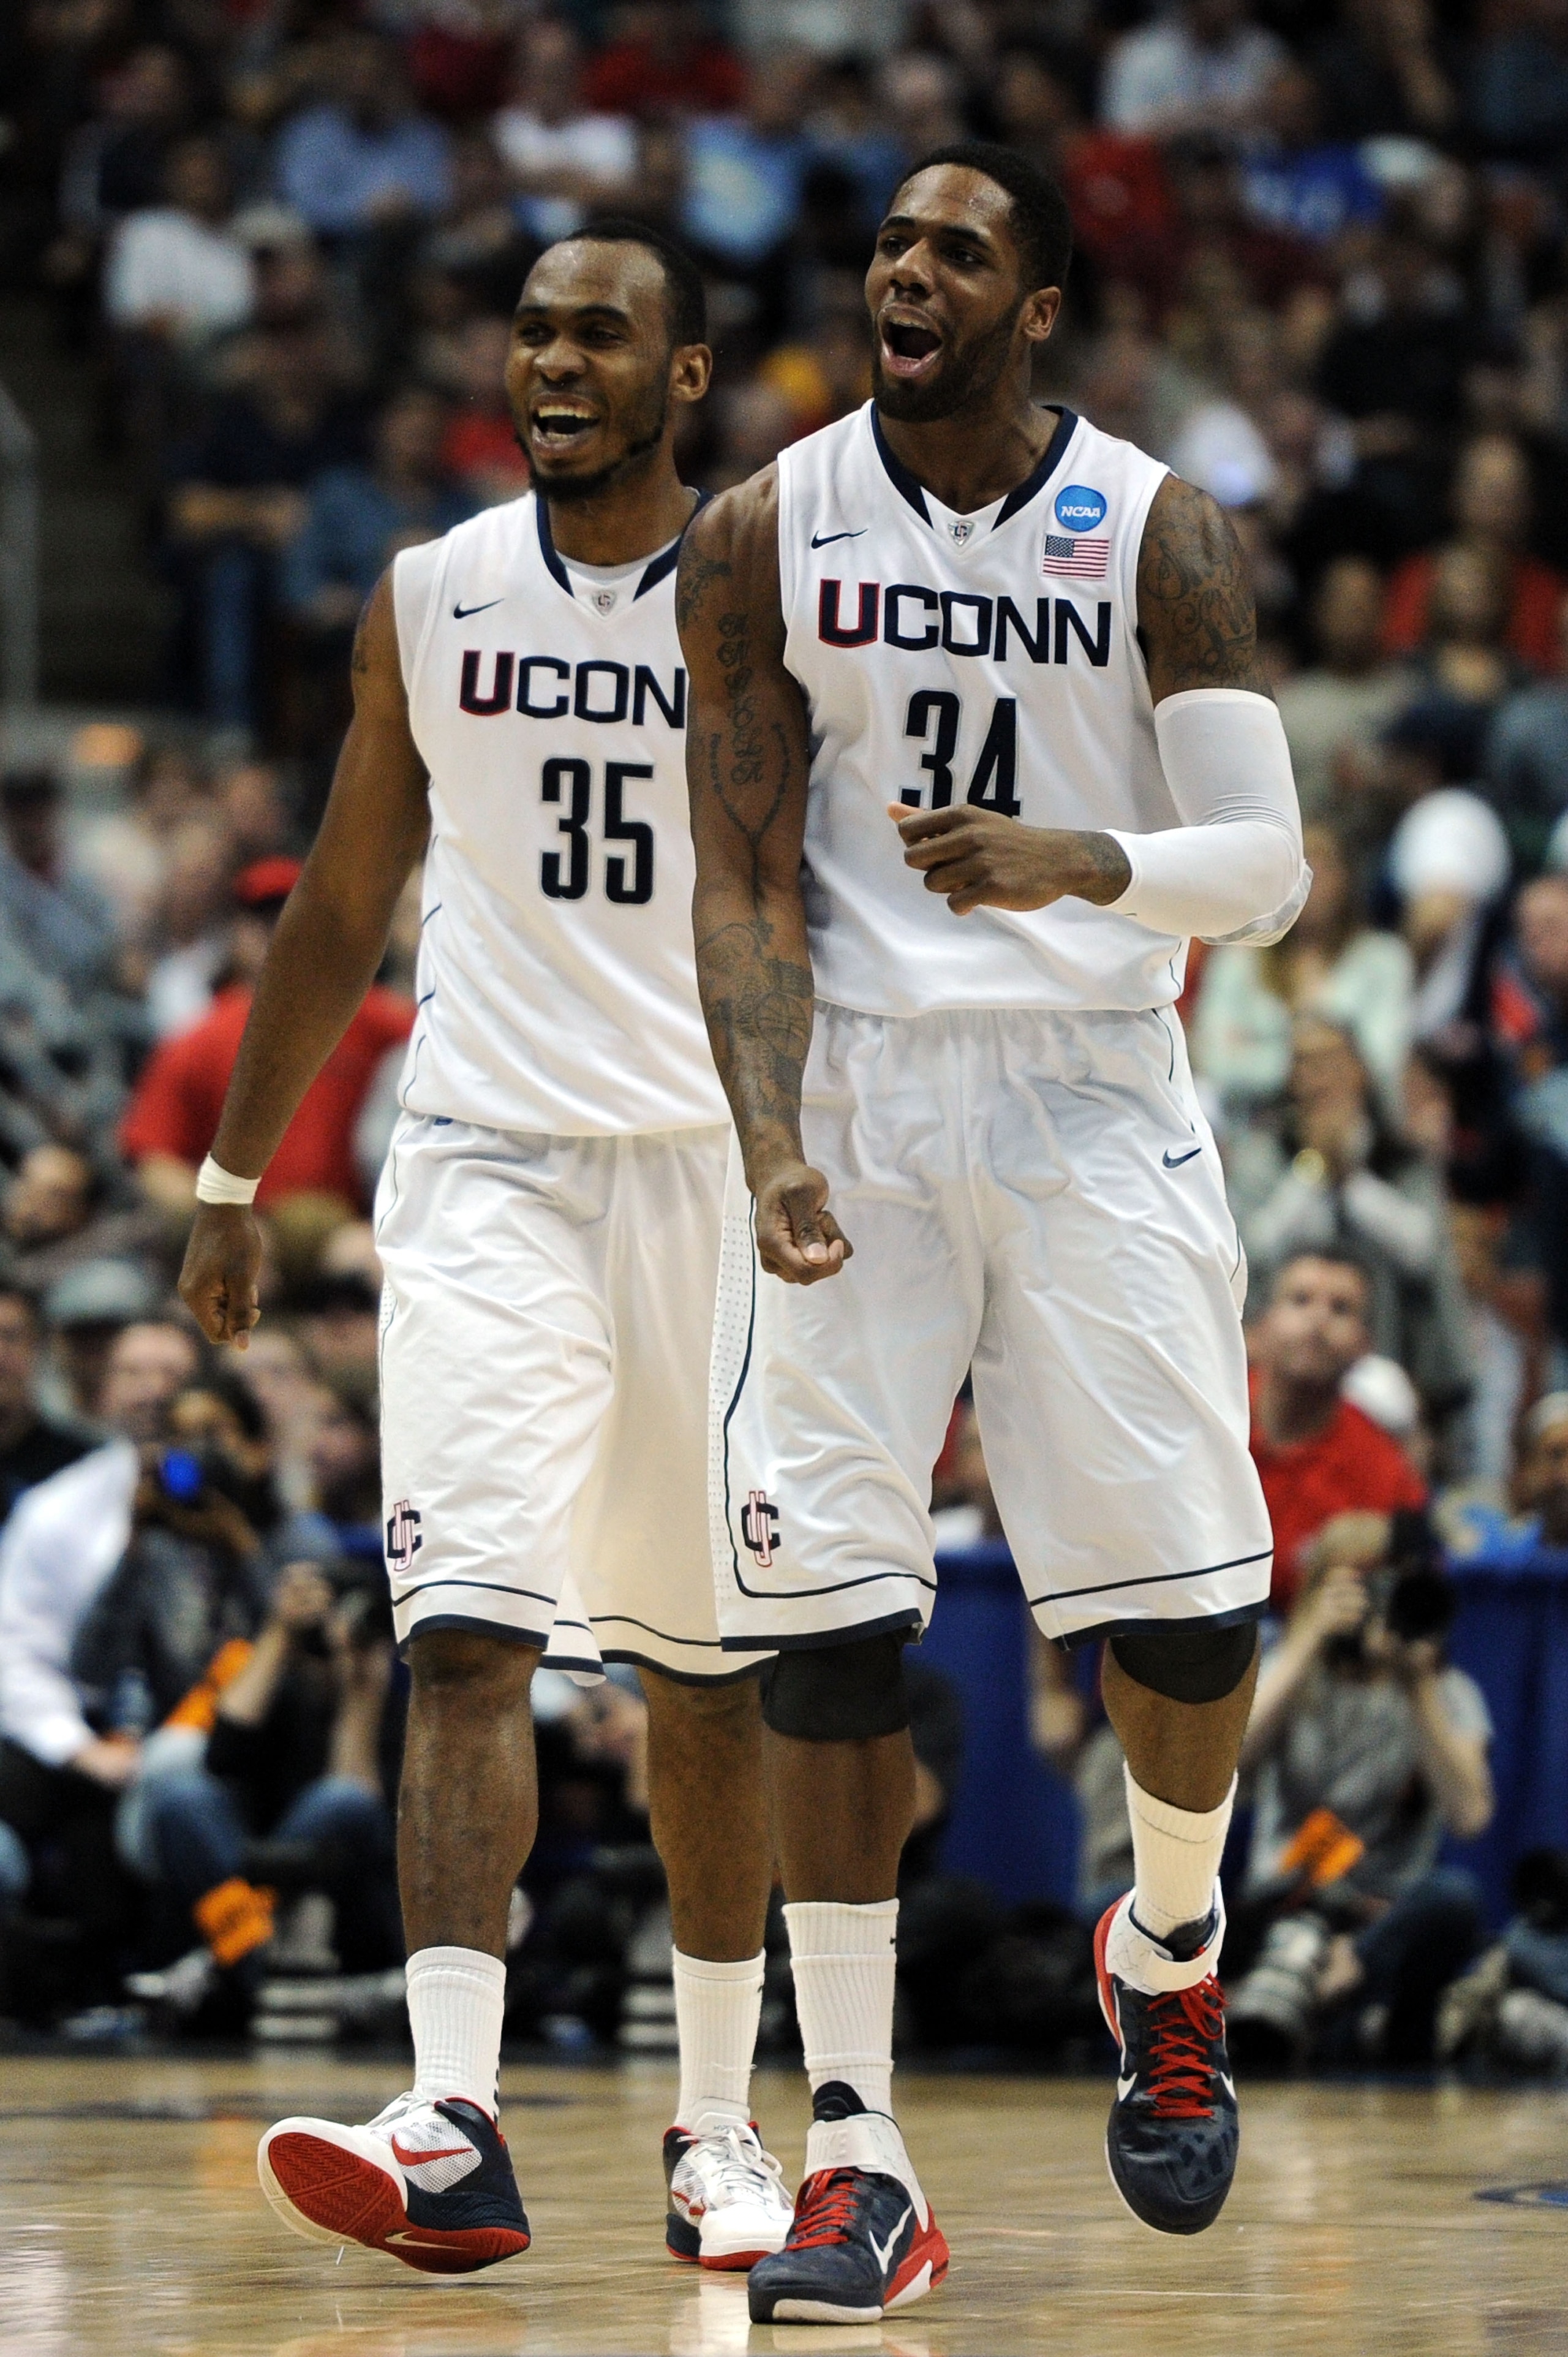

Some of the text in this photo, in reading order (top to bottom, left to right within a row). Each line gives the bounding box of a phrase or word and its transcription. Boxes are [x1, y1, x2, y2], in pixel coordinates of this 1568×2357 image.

[1061, 505, 1101, 518] NCAA
[818, 578, 1112, 667] UCONN
[898, 687, 1022, 819] 34
[540, 755, 655, 907] 35
